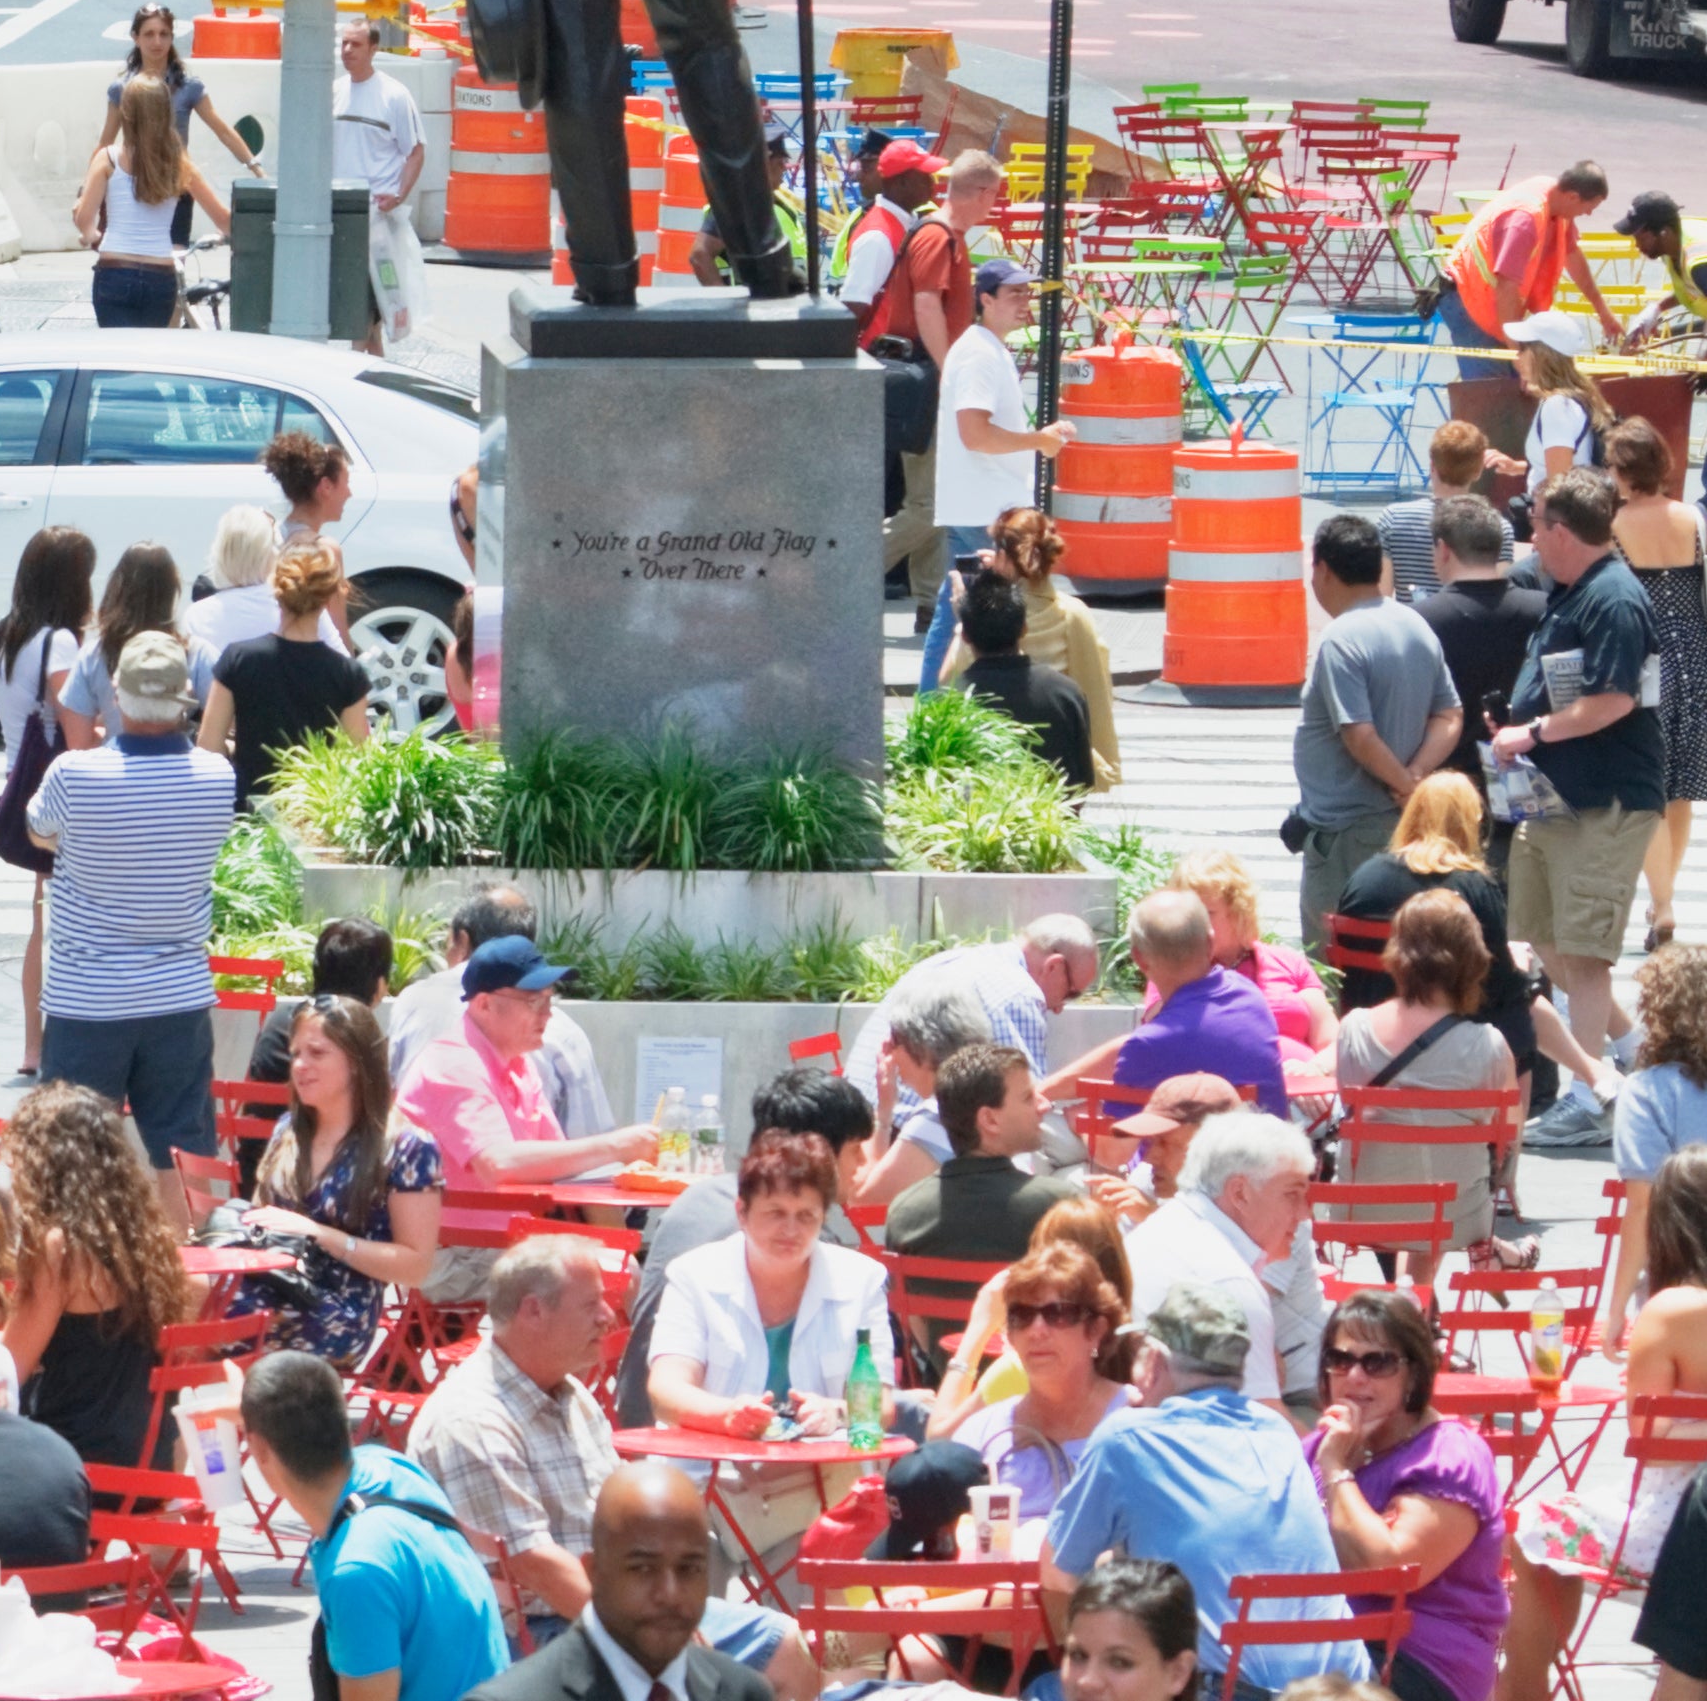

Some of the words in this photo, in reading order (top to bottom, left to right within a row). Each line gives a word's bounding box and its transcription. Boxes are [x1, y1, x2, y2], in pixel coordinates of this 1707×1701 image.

[573, 531, 628, 557] You're
[636, 536, 650, 550] a
[657, 530, 723, 556] Grand
[728, 530, 766, 551] Old
[769, 528, 817, 557] Flag
[639, 557, 688, 581] Over
[692, 557, 746, 580] There
